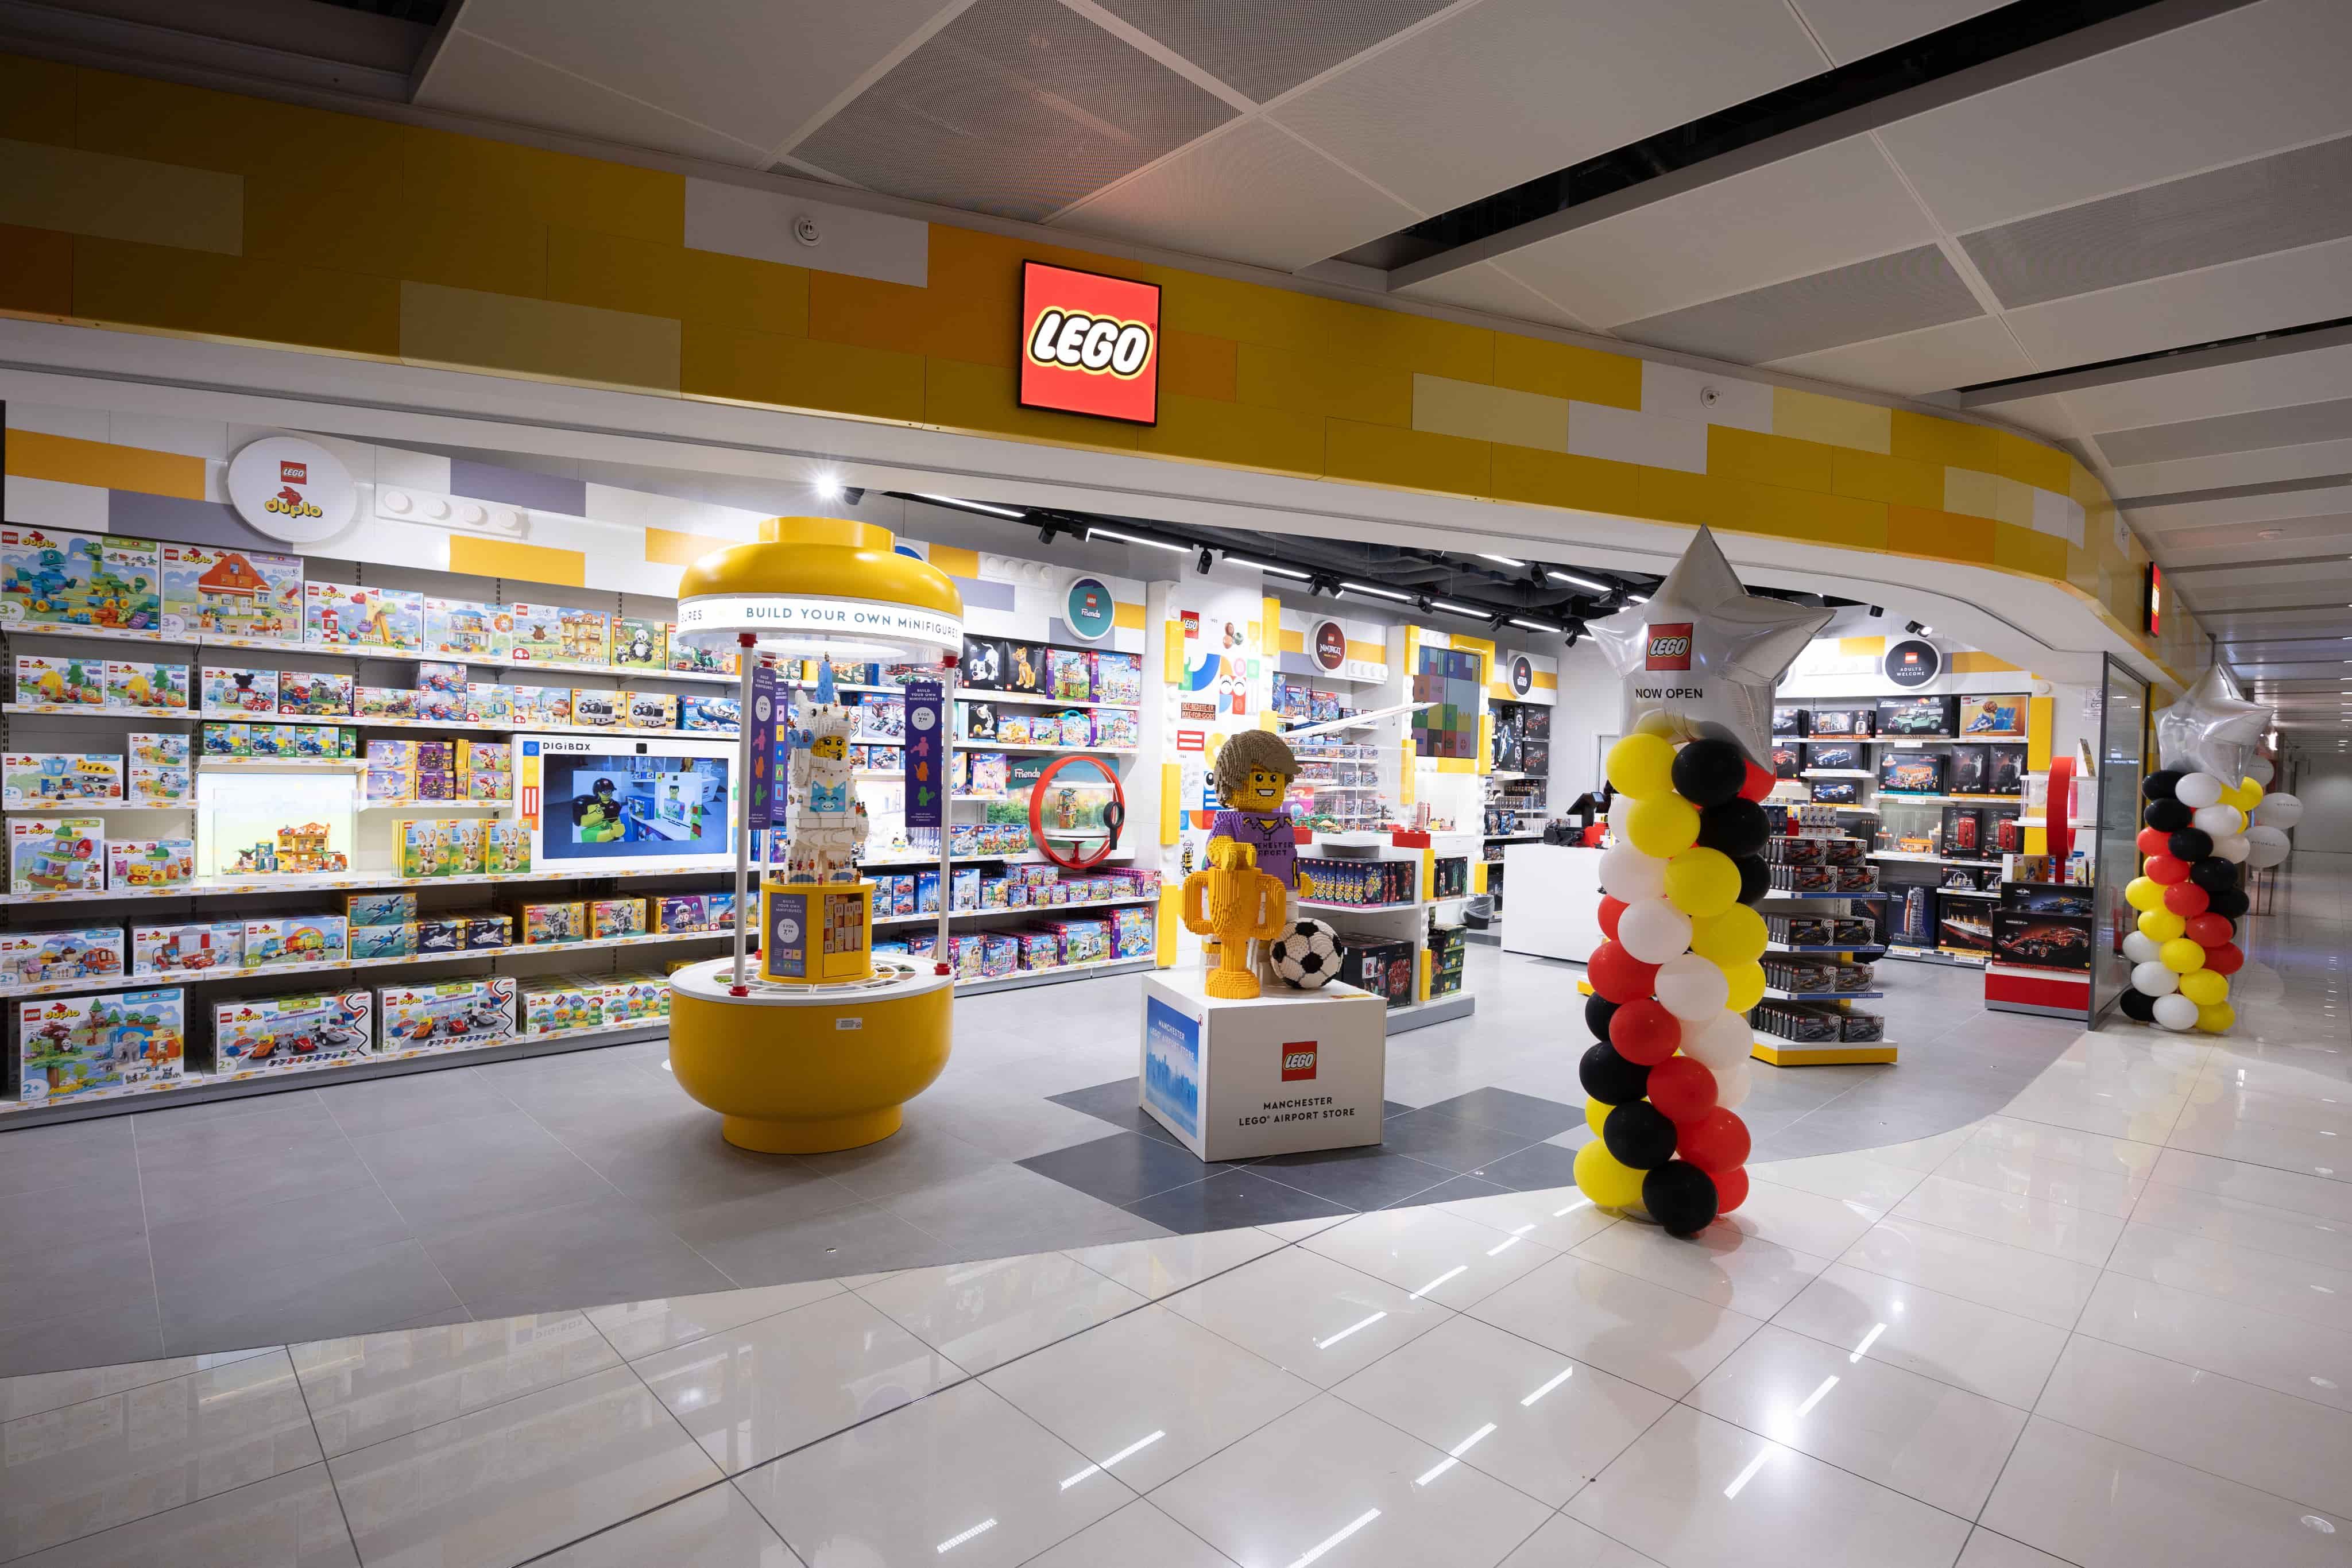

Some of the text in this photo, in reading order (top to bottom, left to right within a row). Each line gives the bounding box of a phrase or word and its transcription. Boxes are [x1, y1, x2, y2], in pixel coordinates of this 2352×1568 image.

[1031, 310, 1150, 375] LEGO
[283, 468, 305, 478] LEGO
[265, 497, 323, 518] duplo
[21, 537, 57, 548] duplo
[181, 553, 212, 564] duplo
[747, 607, 792, 618] BUILD
[800, 609, 845, 621] YOUR
[854, 613, 891, 625] OWN
[1081, 608, 1101, 619] Friends
[163, 618, 177, 627] 3+
[1650, 638, 1688, 656] LEGO
[515, 649, 529, 659] 4+
[1635, 688, 1703, 699] NOW OPEN
[281, 706, 295, 714] 4+
[1015, 767, 1041, 778] Friends
[399, 997, 422, 1005] duplo
[24, 1009, 80, 1020] LEGO duplo
[234, 1013, 262, 1022] duplo
[1158, 1019, 1185, 1040] MANCHESTER
[1181, 1046, 1194, 1061] STORE
[1285, 1054, 1315, 1070] LEGO
[24, 1083, 40, 1094] 2+
[1263, 1097, 1333, 1110] MANCHESTER
[1274, 1111, 1319, 1124] AIRPORT
[1322, 1108, 1355, 1118] STORE
